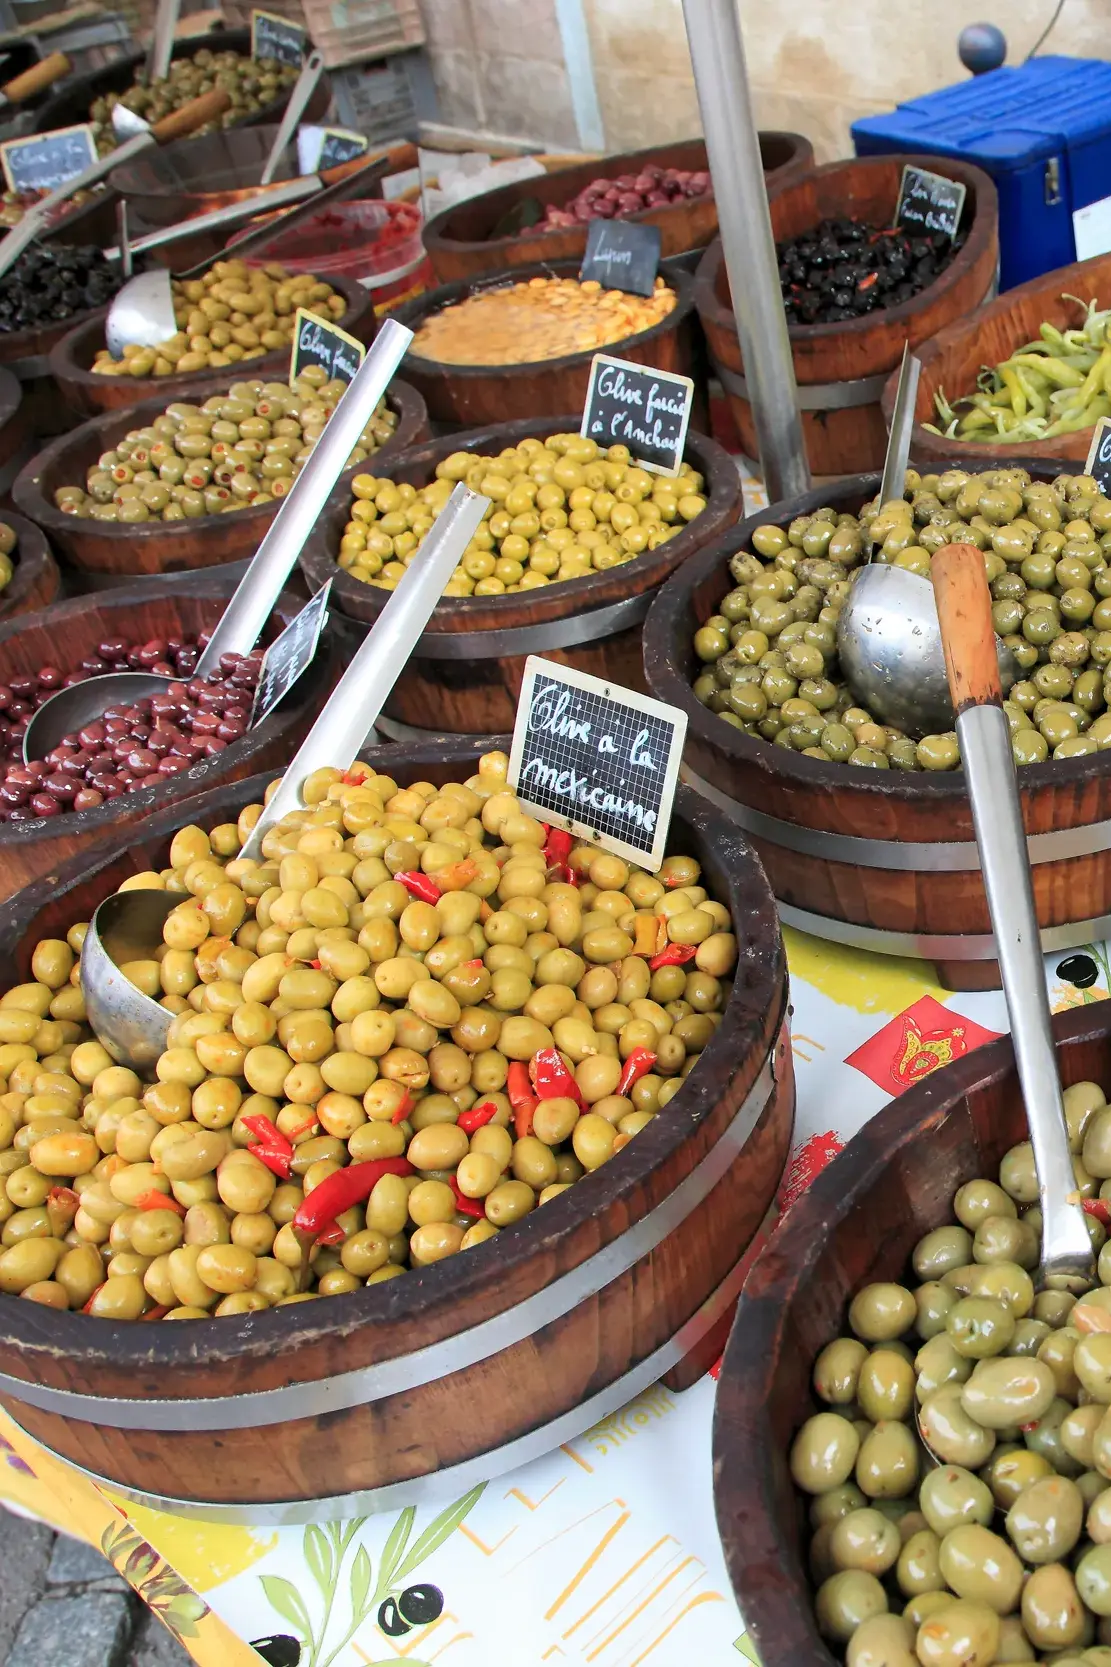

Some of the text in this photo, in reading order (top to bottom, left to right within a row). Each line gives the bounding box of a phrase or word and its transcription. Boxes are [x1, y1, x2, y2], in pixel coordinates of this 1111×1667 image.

[598, 366, 643, 405] Olive
[529, 684, 592, 743] Olive
[630, 728, 659, 770] la
